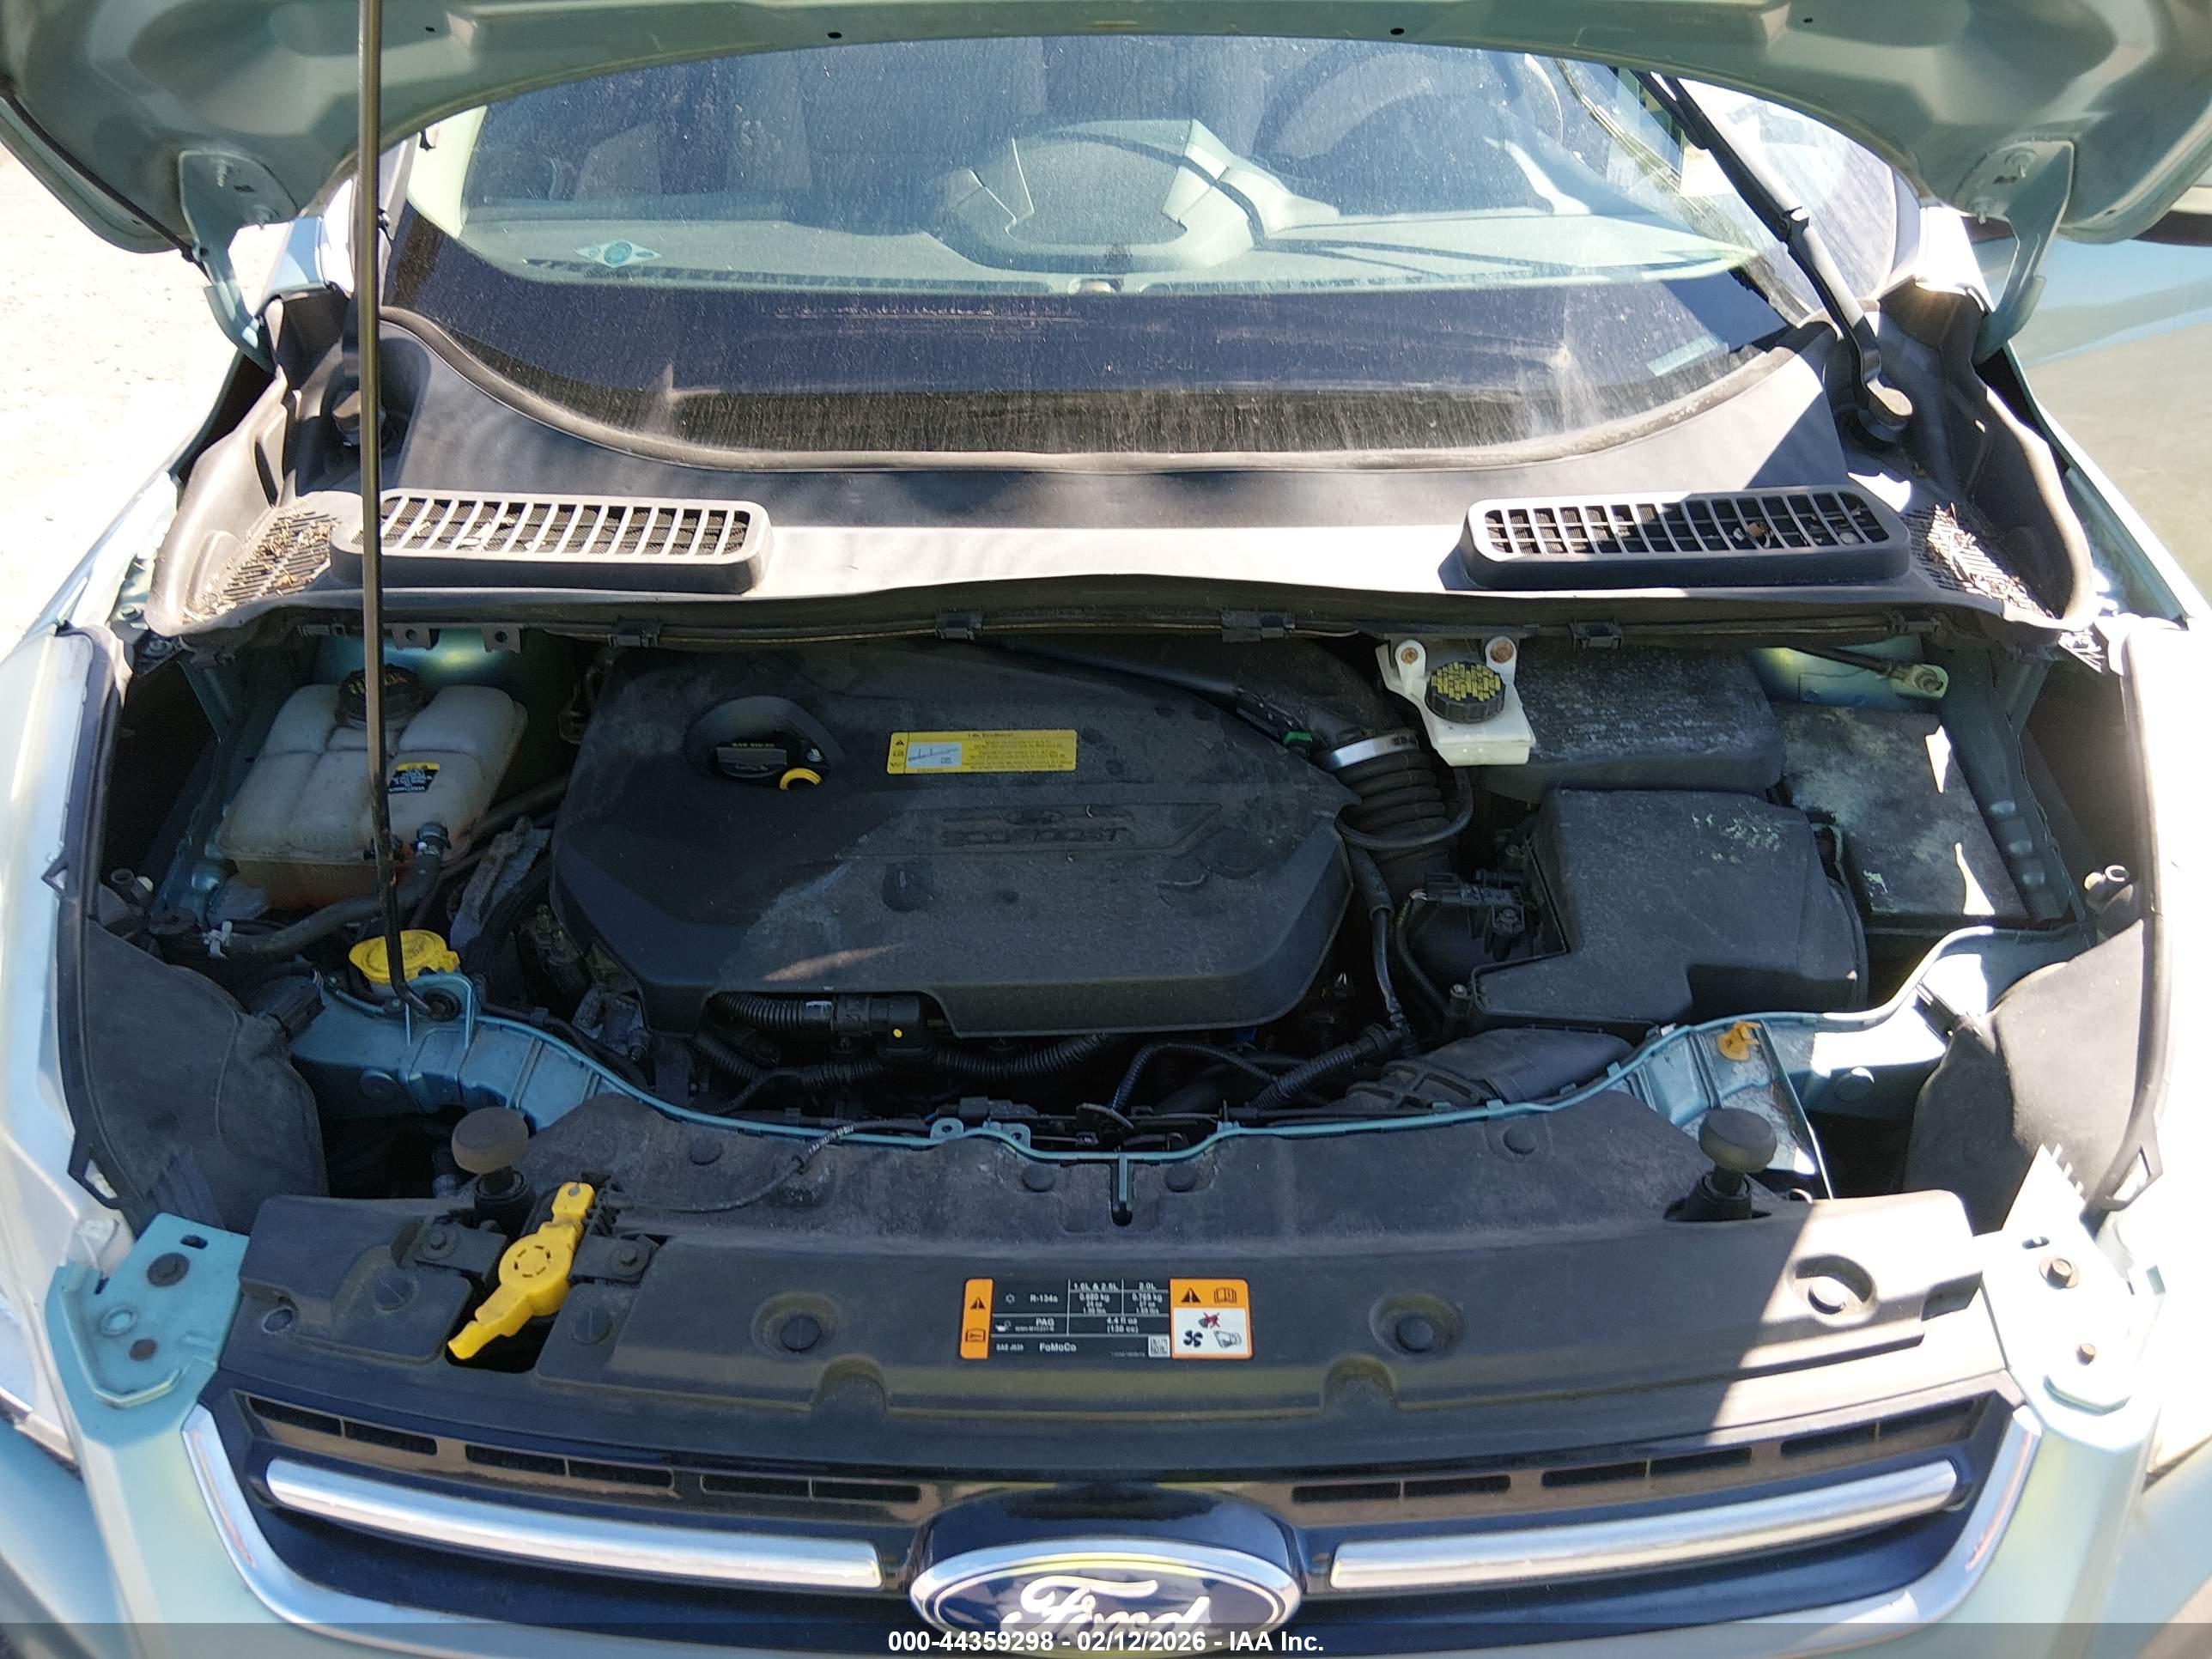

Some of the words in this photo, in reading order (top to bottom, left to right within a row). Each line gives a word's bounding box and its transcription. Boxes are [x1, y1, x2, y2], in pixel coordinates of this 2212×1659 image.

[1030, 1293, 1059, 1303] R-134a
[1036, 1317, 1055, 1327] PAG
[1039, 1341, 1078, 1352] FoMoCo
[1000, 1575, 1211, 1642] Ford
